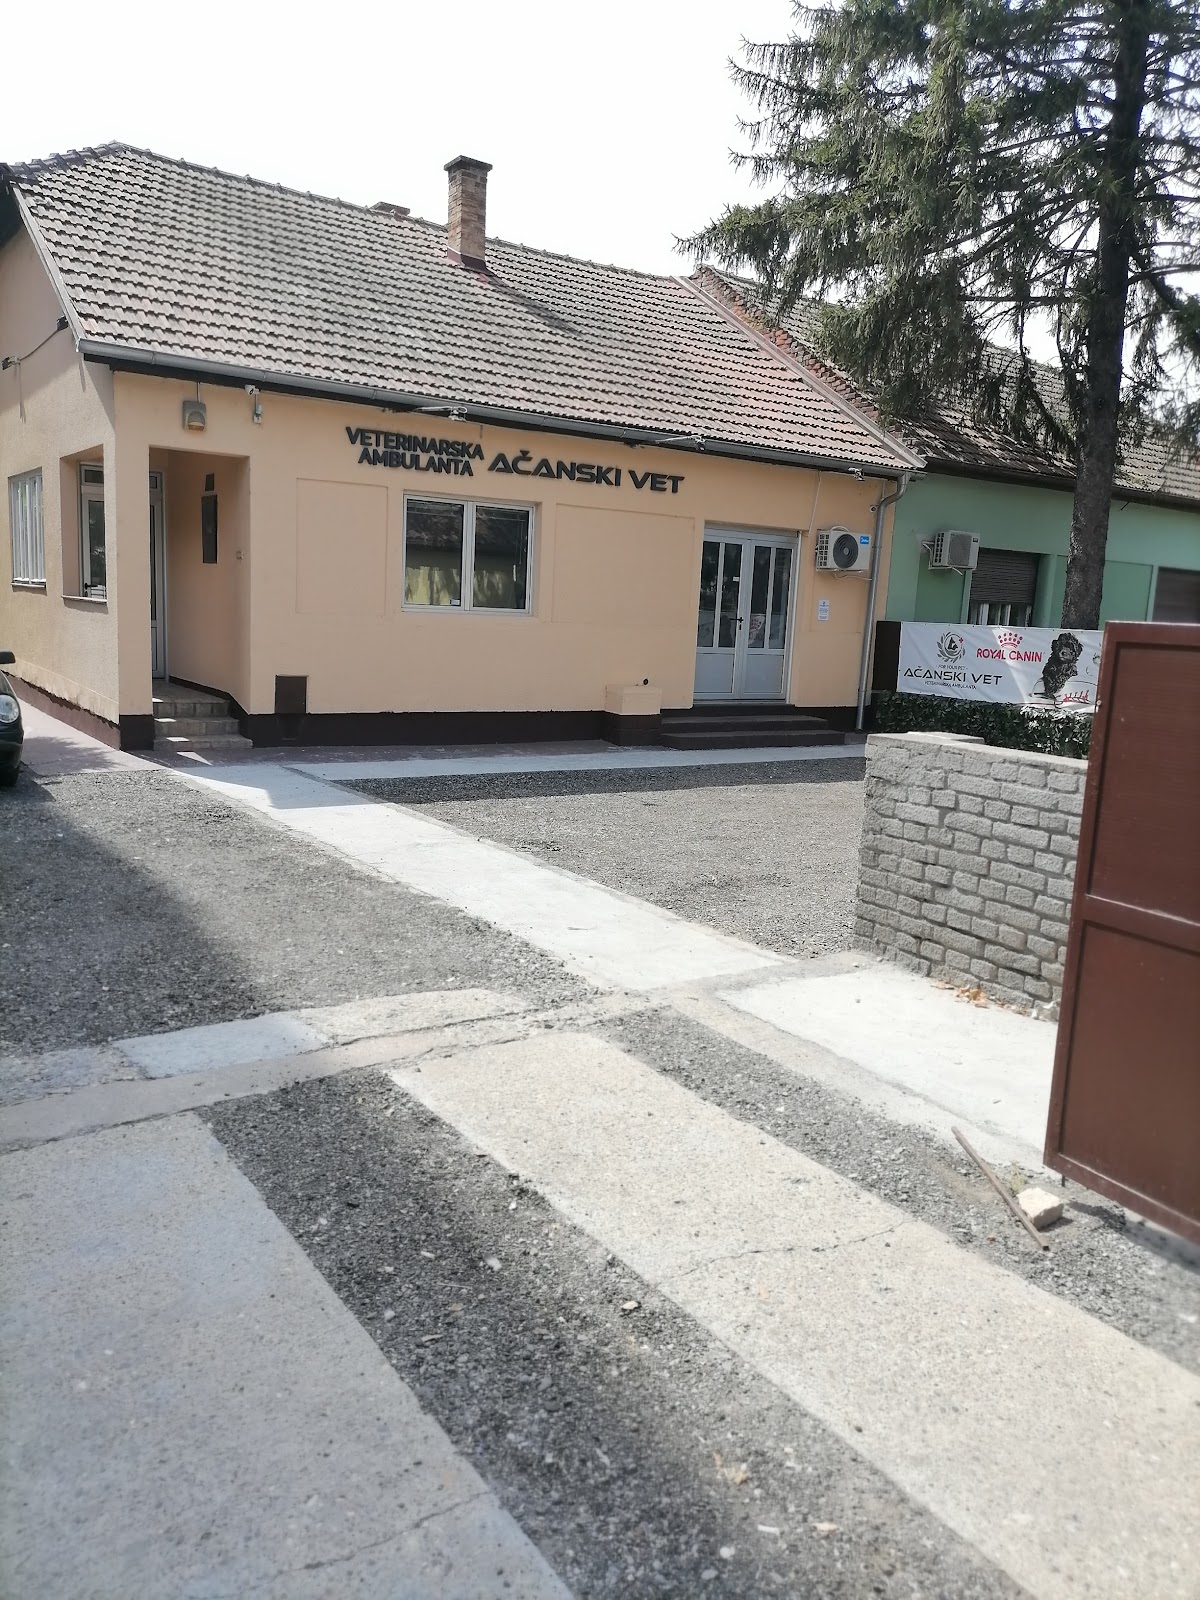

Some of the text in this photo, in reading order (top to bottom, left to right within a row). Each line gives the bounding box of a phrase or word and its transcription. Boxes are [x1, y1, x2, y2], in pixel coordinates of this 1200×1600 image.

[345, 426, 485, 460] VETERINARSKA
[358, 447, 474, 476] AMBULANTA
[487, 450, 685, 494] AČANSKI VET
[976, 648, 1042, 662] ROYAL CANIN
[903, 665, 1003, 686] AČANSKI VET
